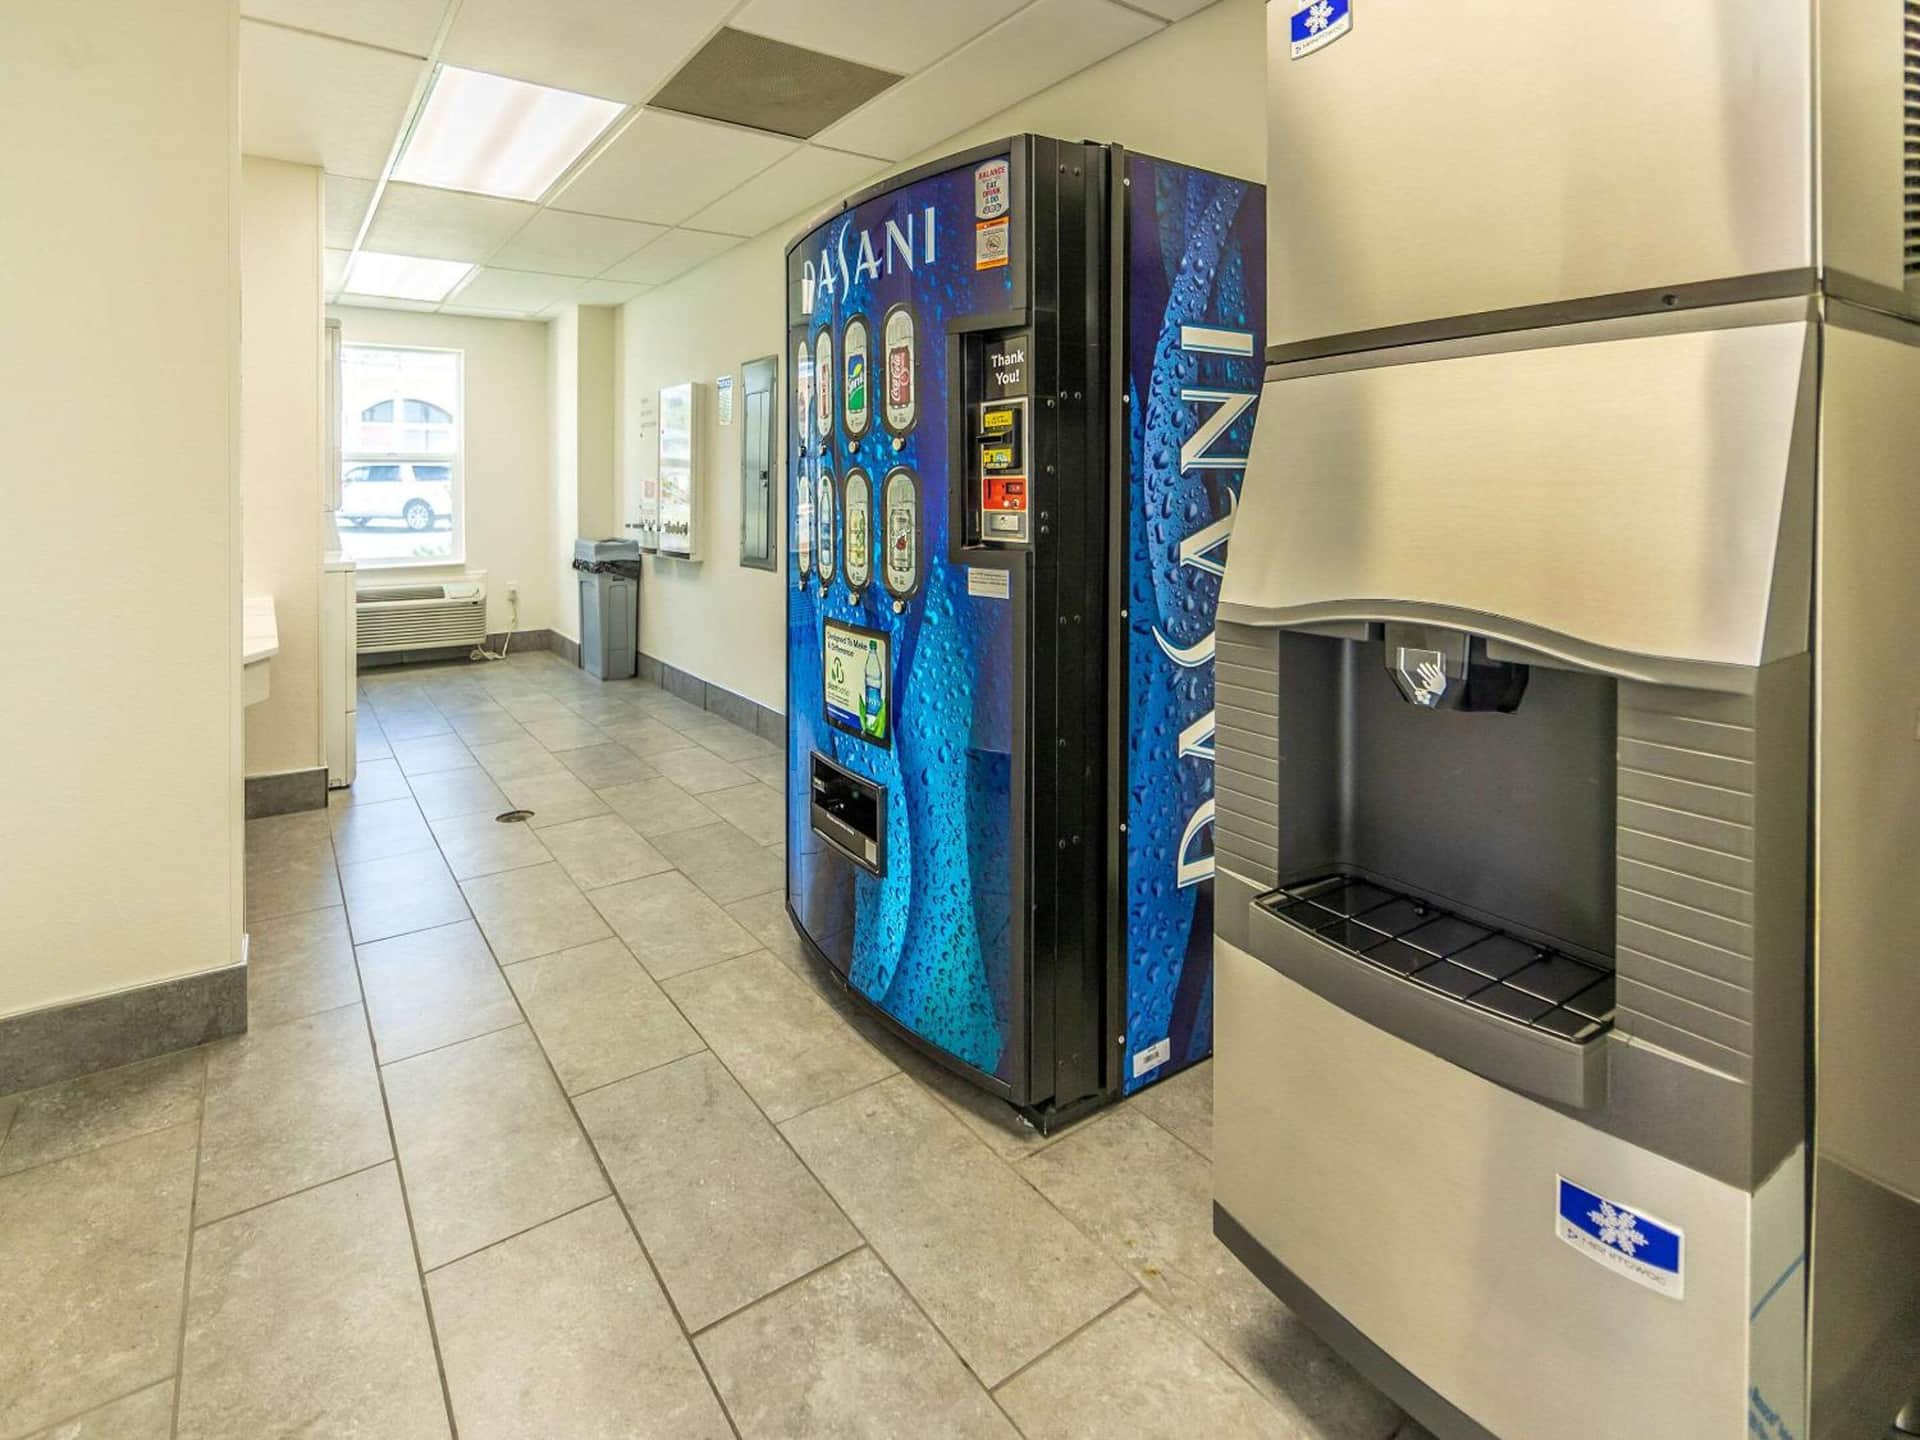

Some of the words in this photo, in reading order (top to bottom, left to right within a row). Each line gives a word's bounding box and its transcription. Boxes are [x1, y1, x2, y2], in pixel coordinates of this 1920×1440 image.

[801, 206, 935, 315] DASANI
[991, 349, 1025, 368] Thank
[995, 369, 1020, 385] You!
[853, 639, 868, 651] Make
